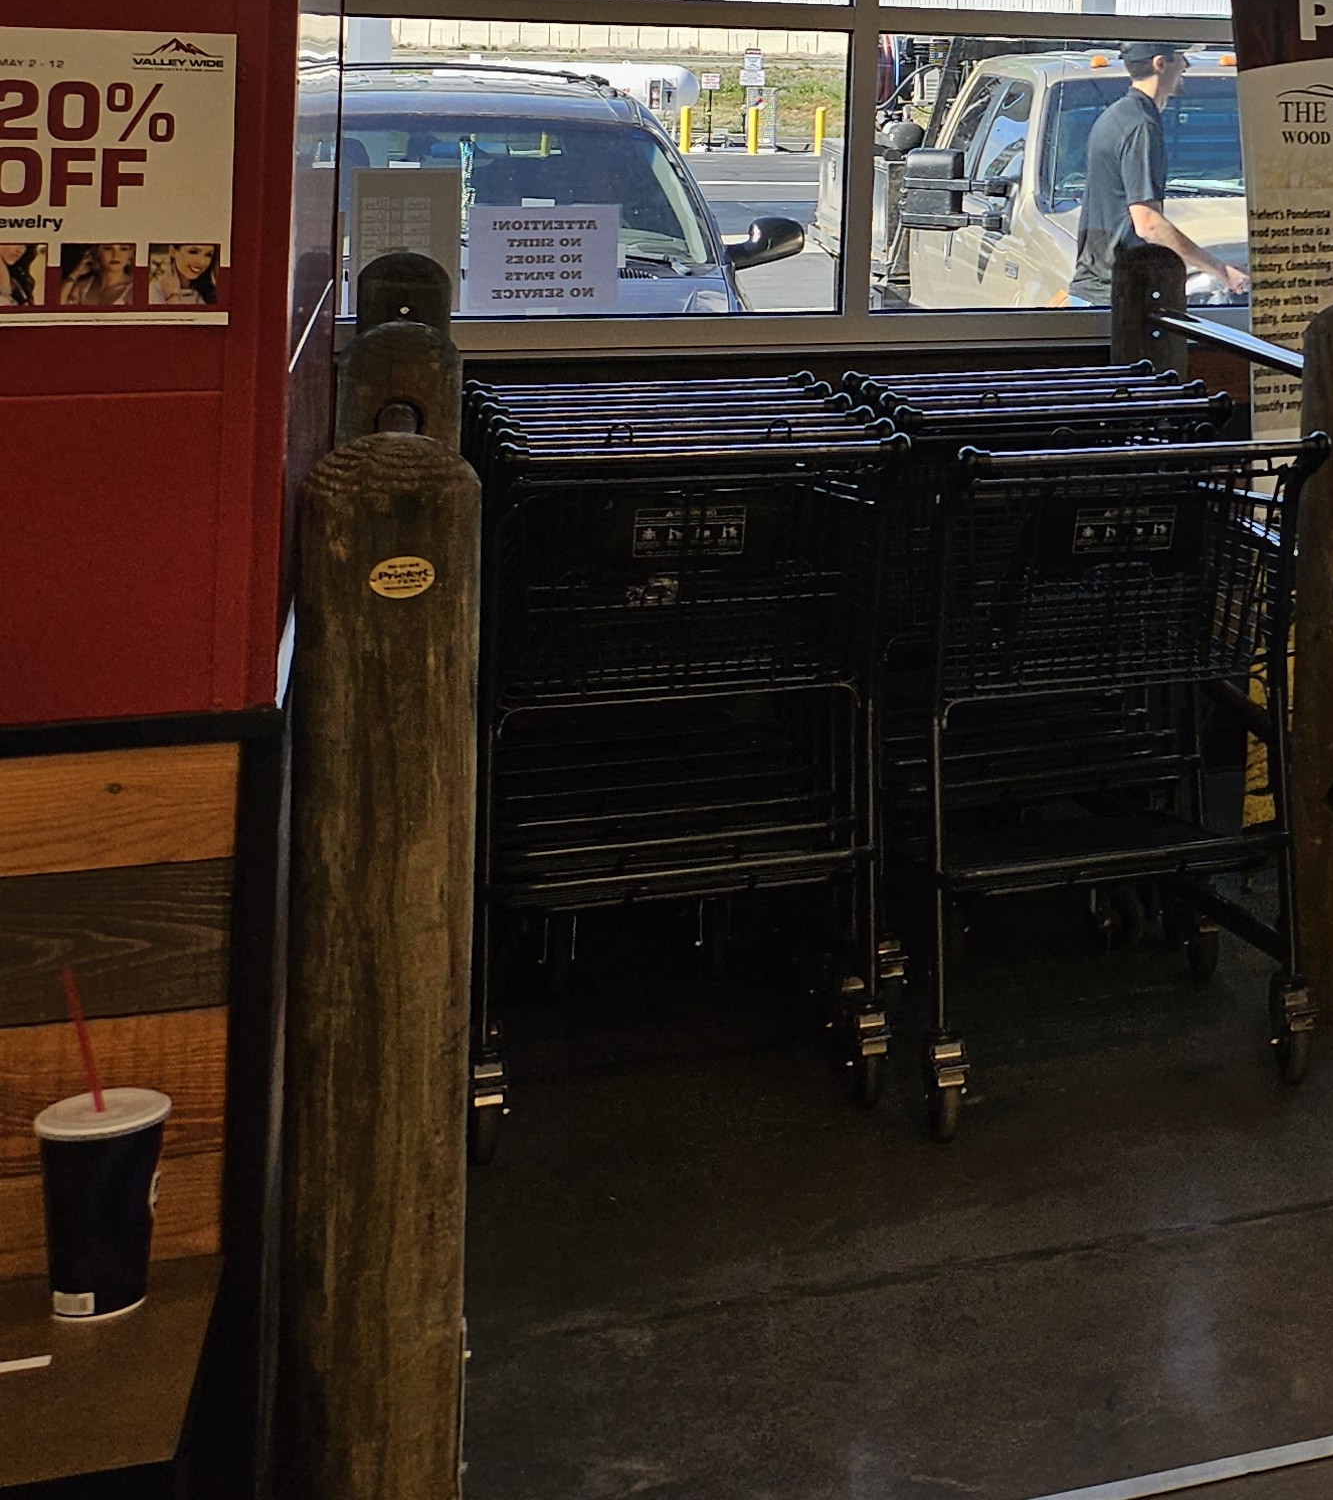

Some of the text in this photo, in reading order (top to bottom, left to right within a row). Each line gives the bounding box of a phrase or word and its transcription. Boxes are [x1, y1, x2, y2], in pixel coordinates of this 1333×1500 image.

[0, 58, 23, 67] MAY
[28, 59, 37, 68] 2
[49, 59, 65, 68] 12
[133, 57, 224, 67] VALLEY WIDE
[0, 79, 175, 142] 20%
[1279, 101, 1327, 123] THE
[1282, 131, 1330, 145] WOOD
[0, 147, 147, 207] OFF
[0, 215, 63, 231] ewelry
